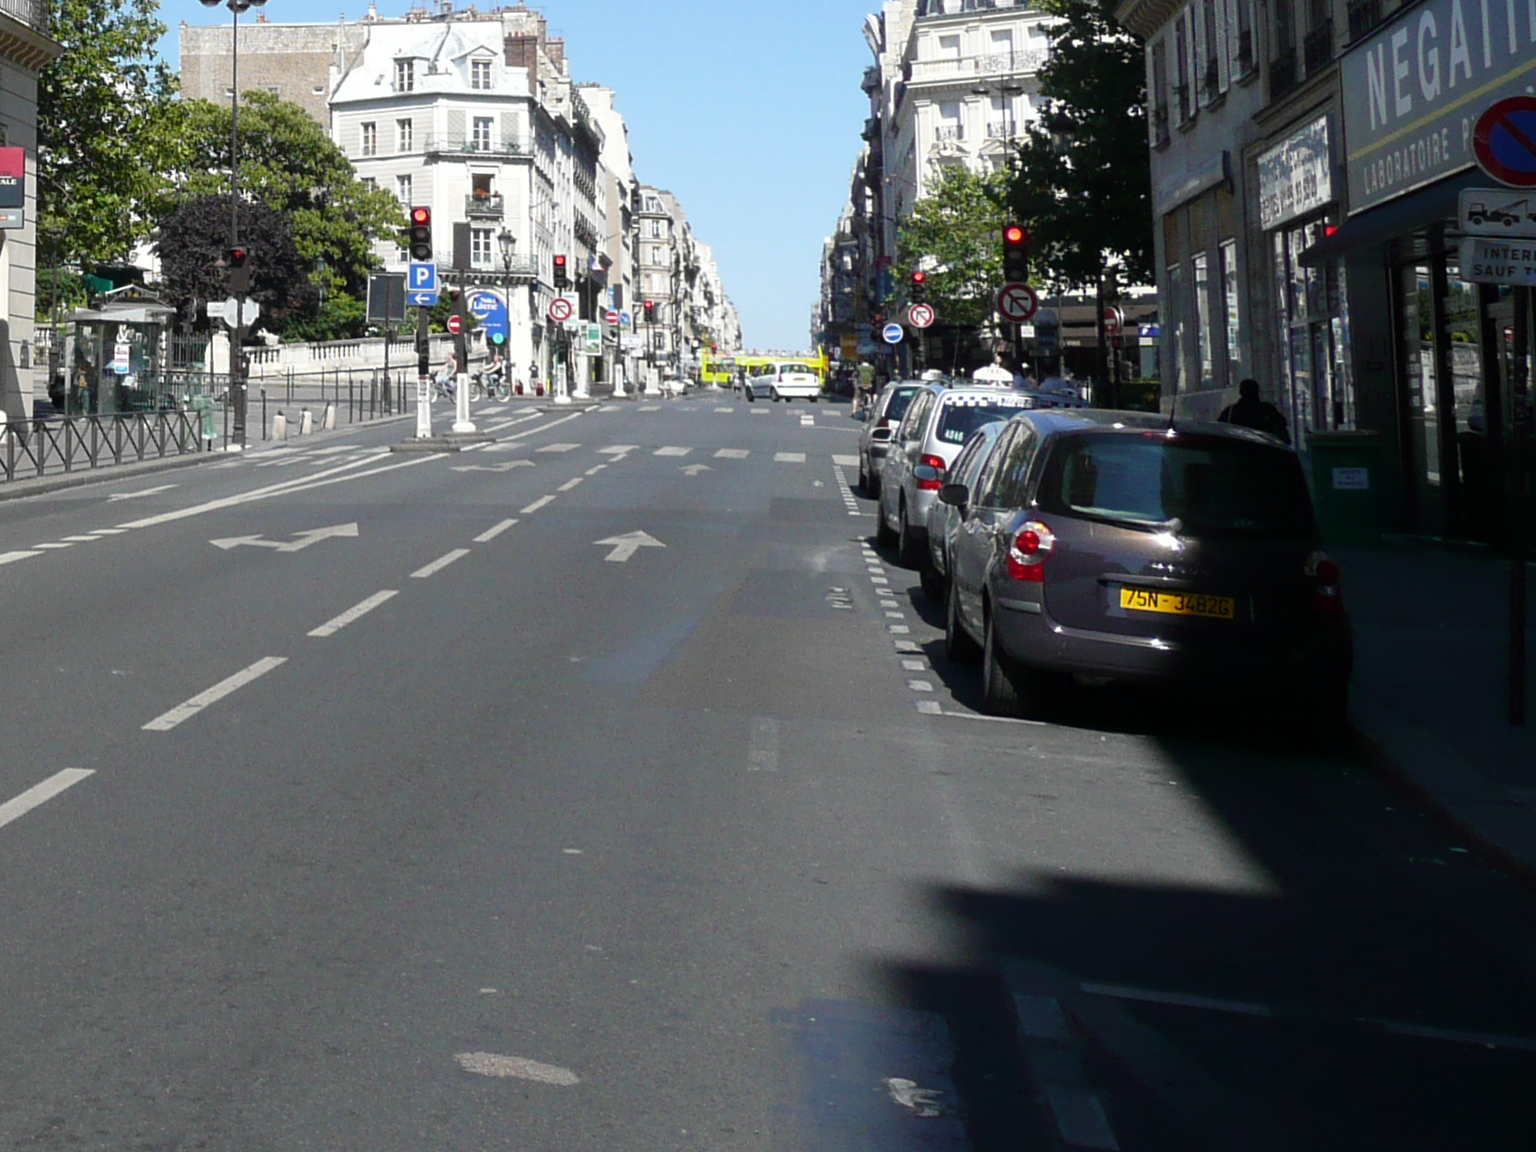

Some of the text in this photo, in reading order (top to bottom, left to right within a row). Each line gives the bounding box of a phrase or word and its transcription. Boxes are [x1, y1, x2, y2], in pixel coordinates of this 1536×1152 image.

[1364, 127, 1450, 195] LABORATOIRE
[1483, 248, 1536, 261] INTER
[416, 267, 430, 286] P
[1474, 264, 1517, 277] SAUF
[1126, 589, 1159, 608] 75N
